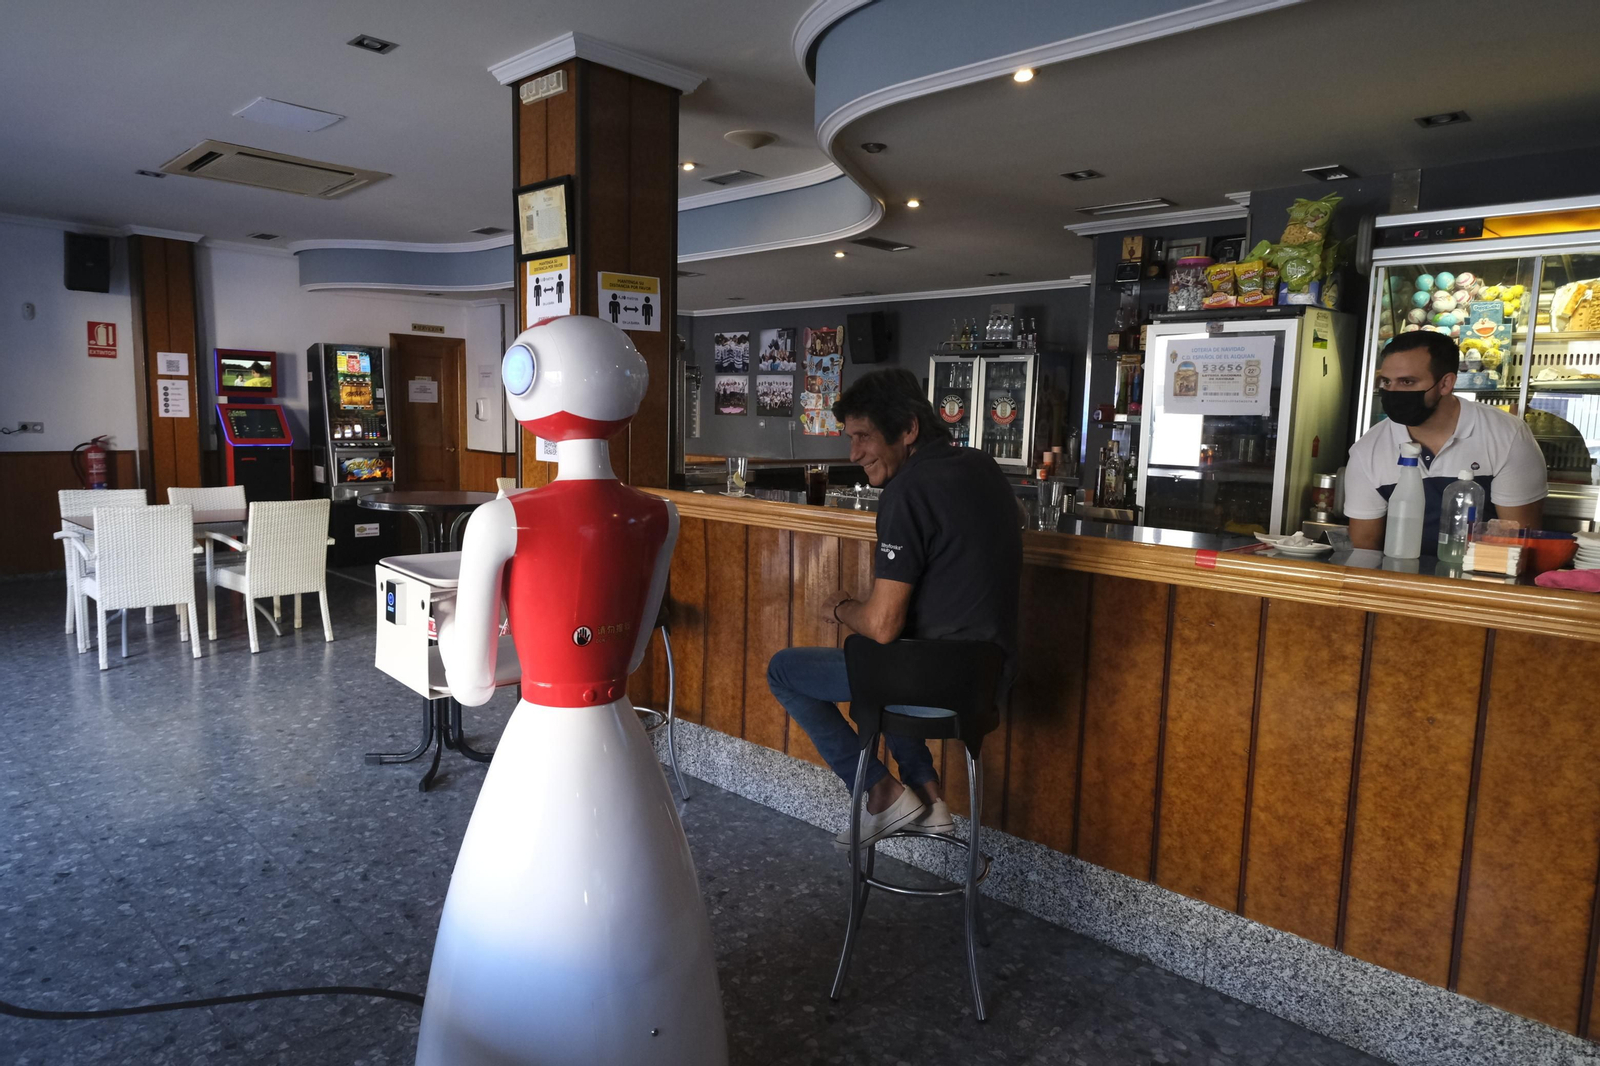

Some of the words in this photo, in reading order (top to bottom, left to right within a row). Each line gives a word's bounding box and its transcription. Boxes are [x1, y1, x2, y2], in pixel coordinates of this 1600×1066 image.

[1244, 293, 1262, 303] Damel
[1202, 364, 1243, 373] 53656
[992, 397, 1016, 409] ERDINGER
